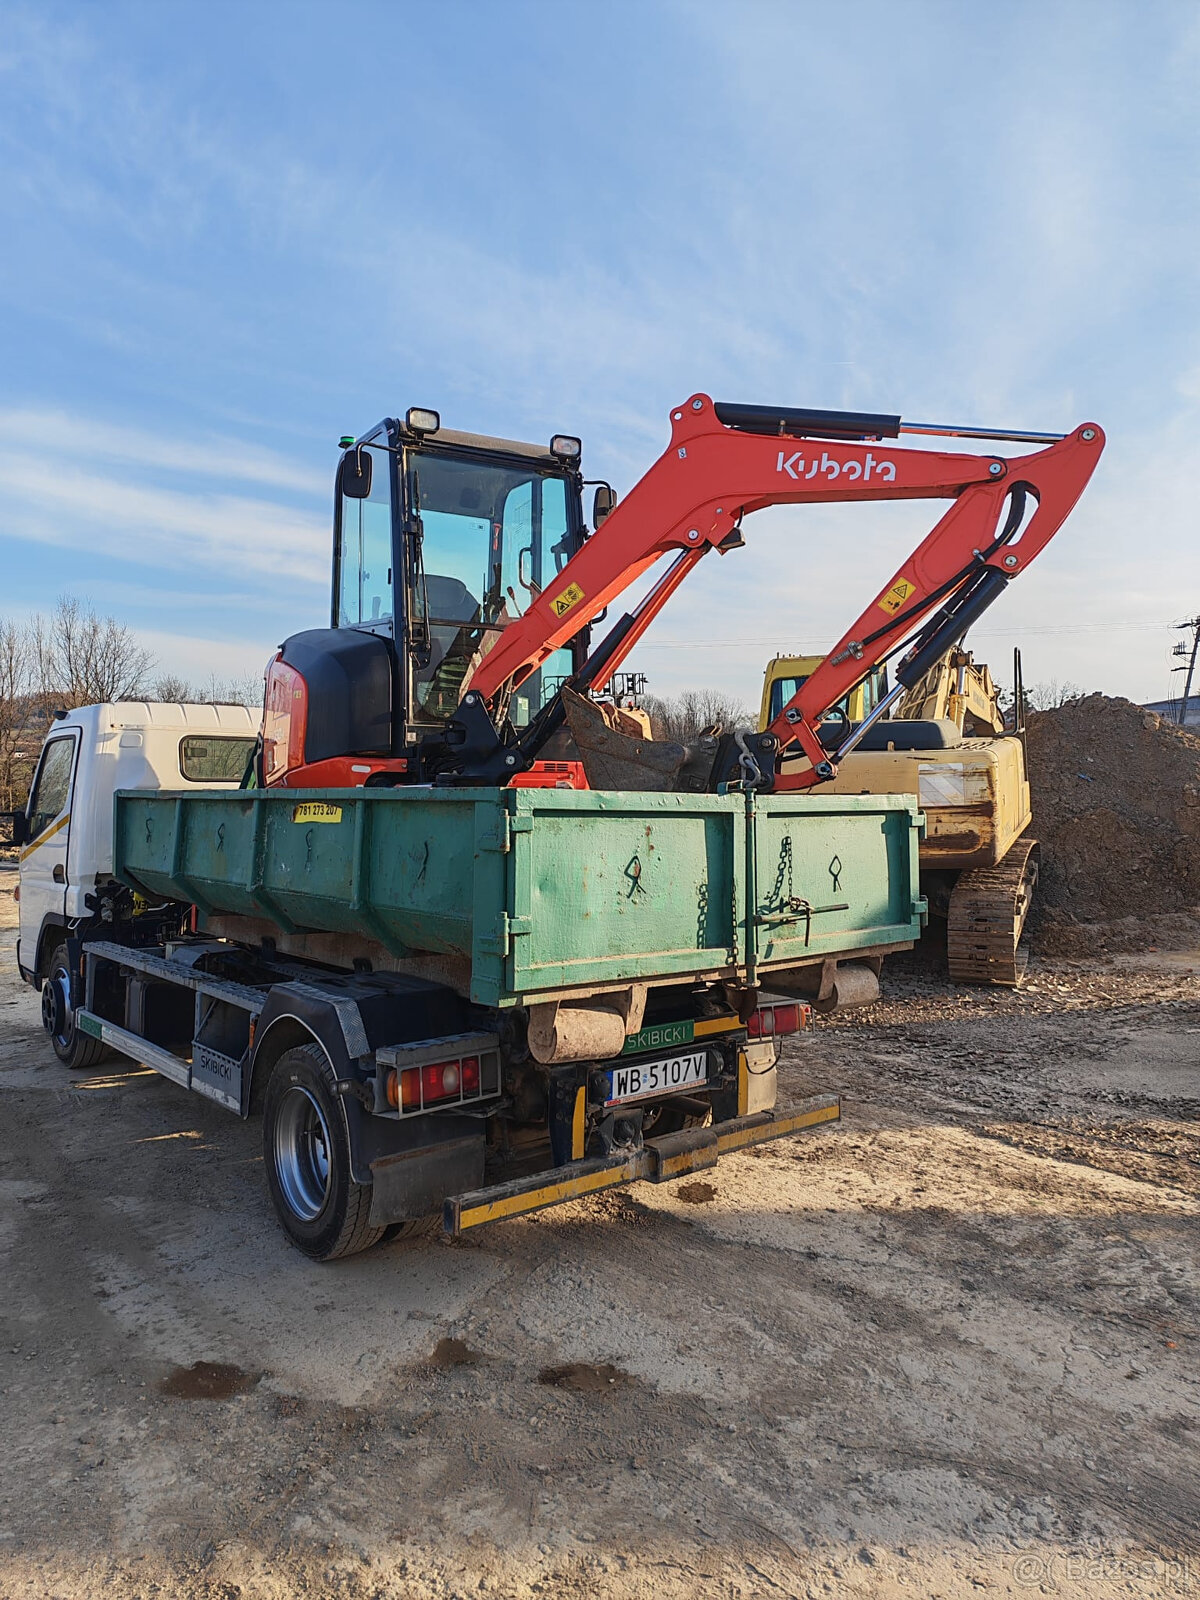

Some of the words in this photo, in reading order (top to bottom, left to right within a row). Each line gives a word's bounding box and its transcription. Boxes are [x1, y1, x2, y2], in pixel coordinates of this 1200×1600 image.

[776, 451, 896, 481] Kubota
[299, 805, 311, 816] 781
[312, 805, 325, 816] 273
[627, 1026, 686, 1049] SKIBICKI
[200, 1055, 232, 1081] SKIBICKI
[617, 1069, 642, 1097] WB
[649, 1055, 703, 1089] 5107V
